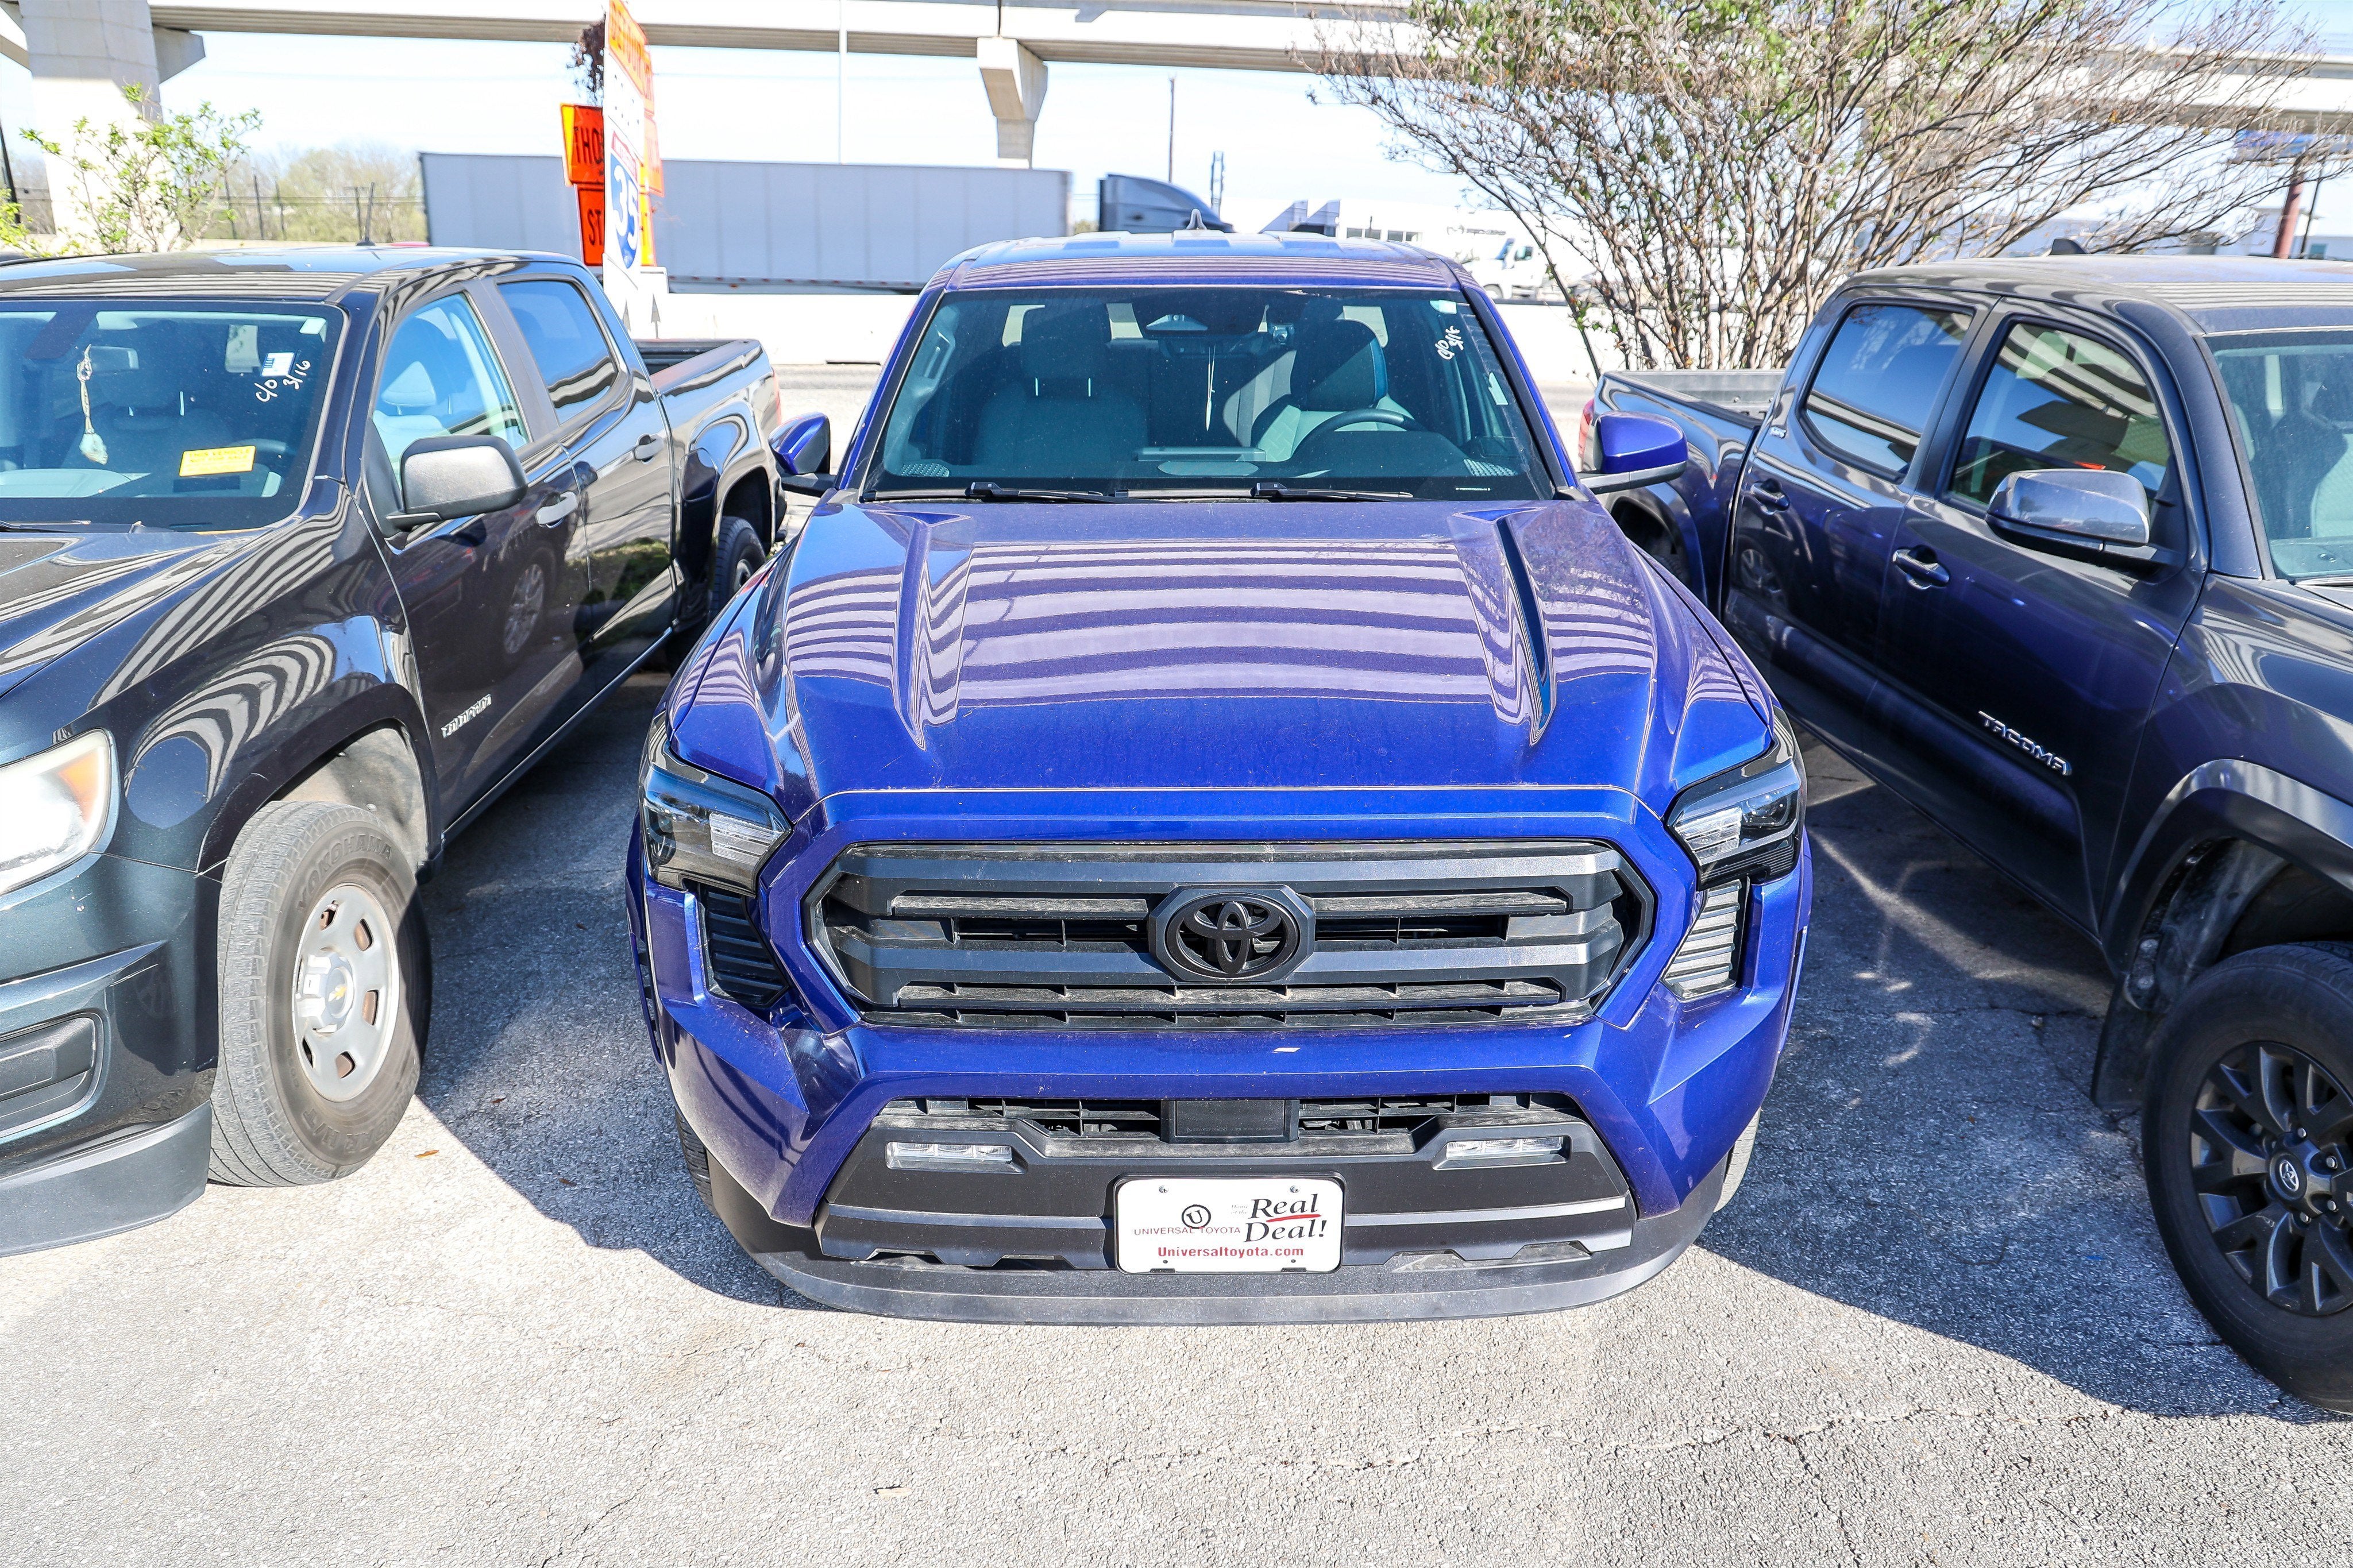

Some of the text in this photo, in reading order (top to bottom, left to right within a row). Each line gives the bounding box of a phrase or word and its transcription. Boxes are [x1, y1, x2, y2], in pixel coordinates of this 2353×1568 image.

[614, 164, 639, 250] 35
[282, 360, 311, 390] 3/16
[1978, 710, 2073, 775] TACOMA
[296, 833, 392, 910] YOKOHAMA
[1248, 1194, 1318, 1219] Real
[1134, 1227, 1195, 1235] UNIVERSAL
[1243, 1219, 1327, 1242] Deal!
[1158, 1246, 1303, 1258] Universaltoyota.com
